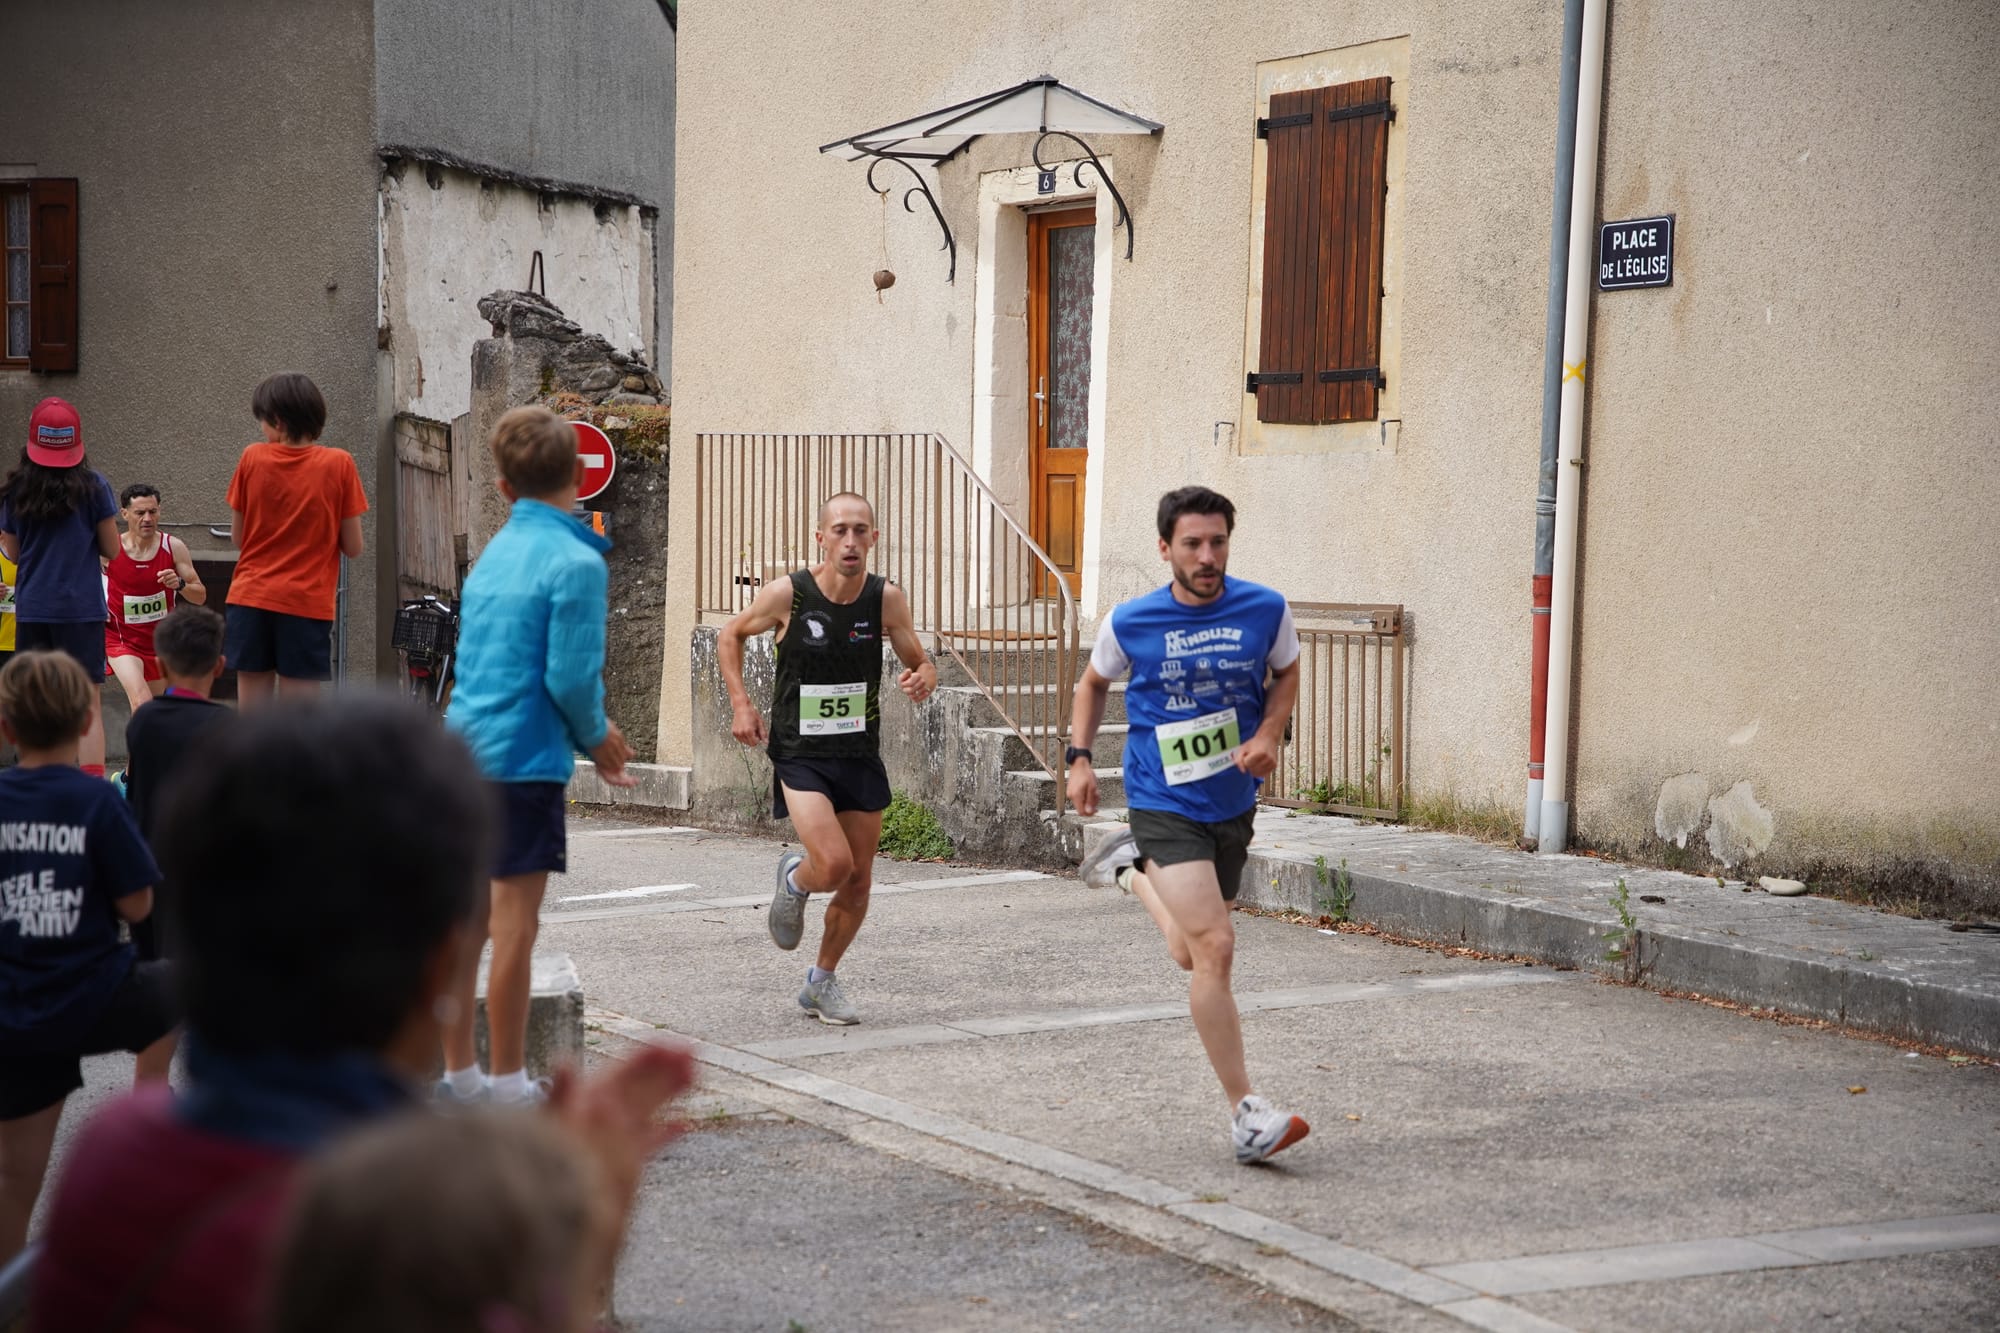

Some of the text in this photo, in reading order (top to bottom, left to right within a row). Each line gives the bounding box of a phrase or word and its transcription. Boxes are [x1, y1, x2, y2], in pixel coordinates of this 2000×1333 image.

[1043, 175, 1050, 190] 6
[1613, 228, 1657, 250] PLACE
[1602, 254, 1666, 279] DE L'ÉGLISE
[131, 601, 161, 614] 100
[819, 698, 850, 718] 55
[1173, 728, 1227, 761] 101
[0, 887, 83, 921] ZERIEN
